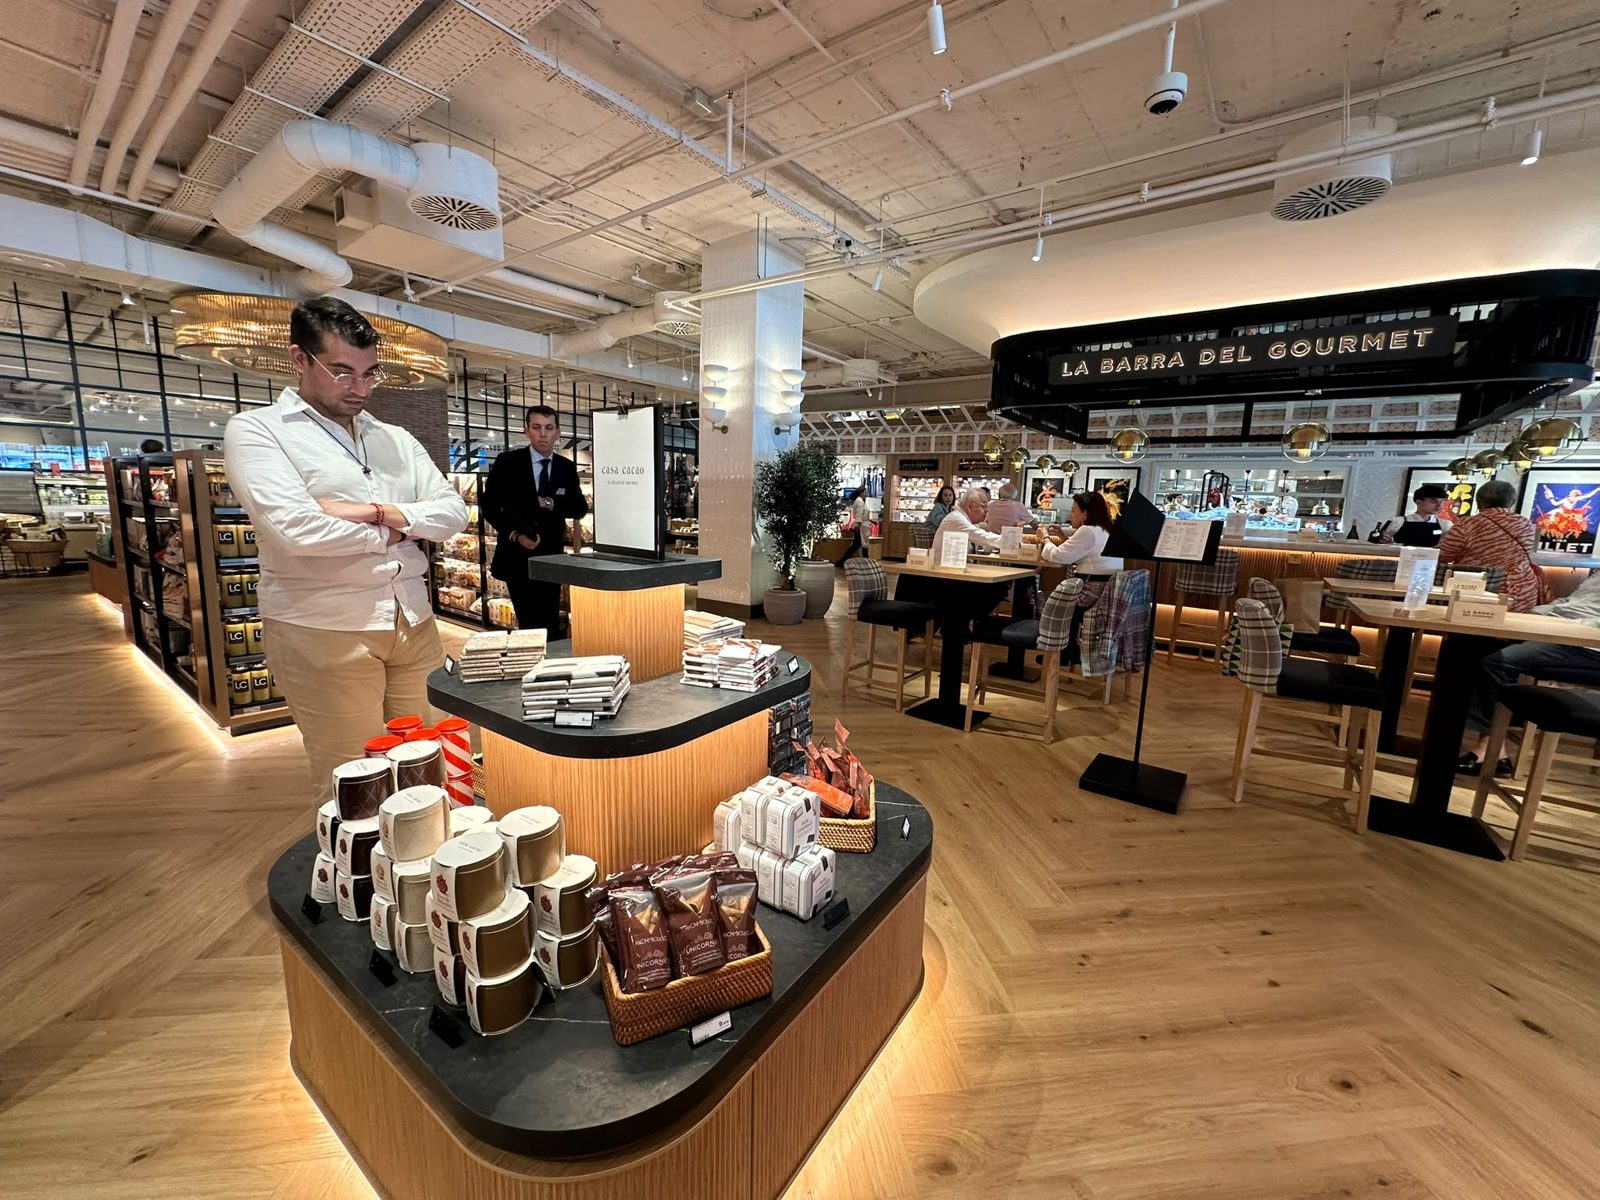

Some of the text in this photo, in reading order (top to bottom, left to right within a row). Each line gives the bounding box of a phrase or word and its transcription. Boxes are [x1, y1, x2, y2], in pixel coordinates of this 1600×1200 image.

[1061, 327, 1434, 377] LA BARRA DEL GOURMET
[601, 466, 645, 475] casa cacao
[219, 532, 232, 541] LC
[1537, 541, 1593, 553] ILLET
[229, 583, 241, 592] LC
[230, 632, 243, 641] LC
[235, 680, 248, 690] LC
[254, 677, 267, 687] LC
